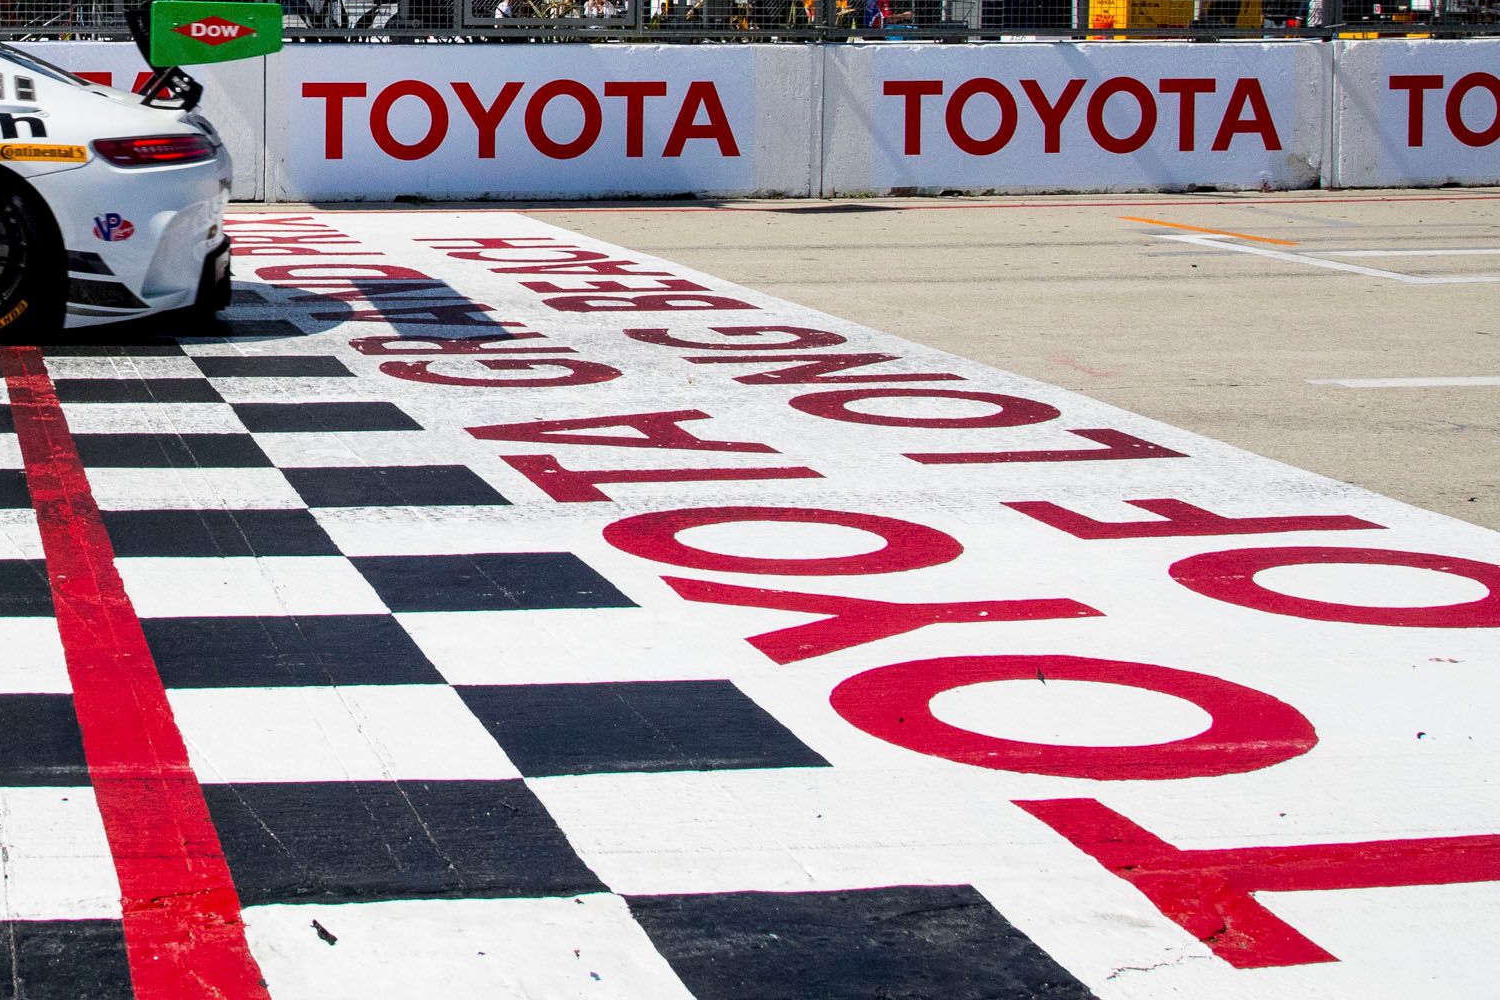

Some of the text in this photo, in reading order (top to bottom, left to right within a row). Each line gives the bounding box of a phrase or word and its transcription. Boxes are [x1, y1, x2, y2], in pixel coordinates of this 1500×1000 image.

[0, 144, 73, 159] Continental
[302, 79, 740, 160] TOYOTA
[884, 77, 1282, 155] TOYOTA
[94, 212, 121, 241] VP
[256, 264, 623, 387] GRAND
[412, 237, 1500, 628] OF LONG BEACH
[464, 410, 1500, 969] TOYOTA
